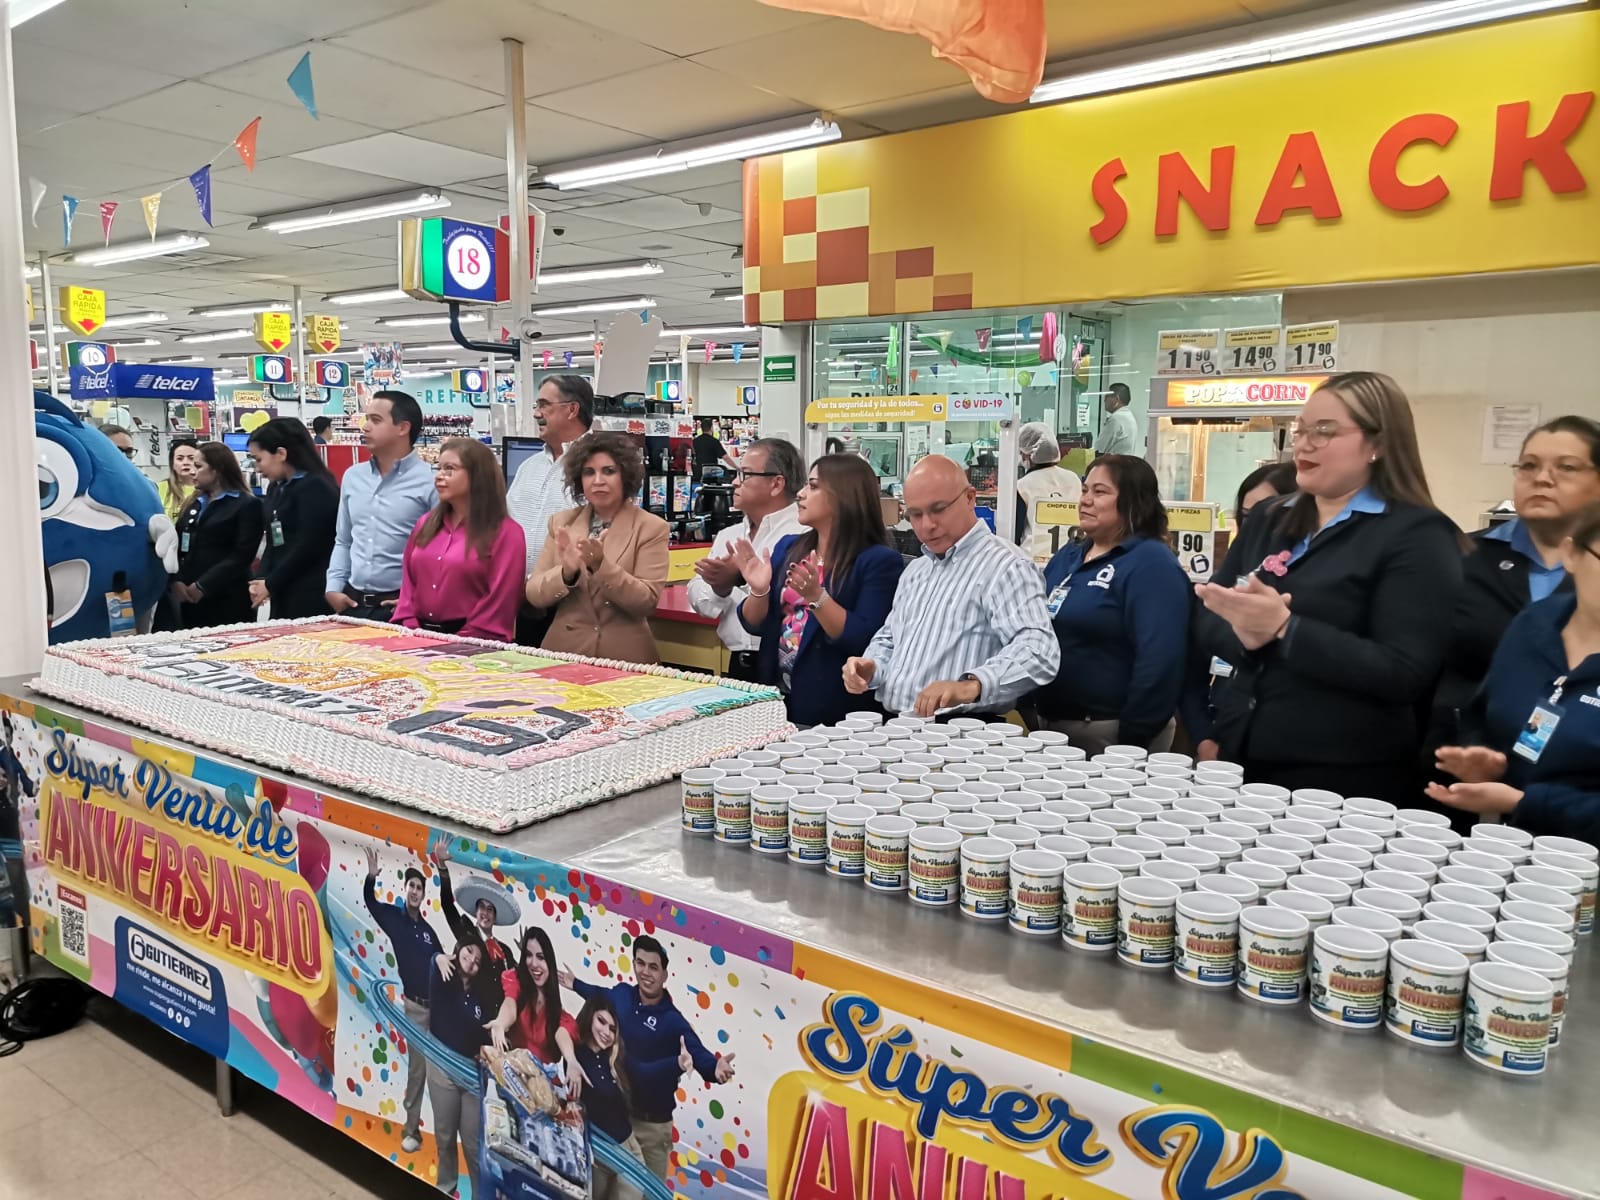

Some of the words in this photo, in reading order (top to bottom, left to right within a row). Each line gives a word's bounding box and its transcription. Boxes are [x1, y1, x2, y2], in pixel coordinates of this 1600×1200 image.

[1089, 90, 1594, 245] SNACK
[457, 247, 481, 275] 18
[77, 293, 98, 302] CAJA
[88, 351, 99, 362] 10
[1233, 346, 1257, 367] 14
[1258, 347, 1273, 359] 90
[1294, 343, 1316, 365] 17
[1318, 342, 1332, 356] 90
[153, 376, 200, 391] telcel
[1247, 384, 1308, 401] CORN
[1182, 533, 1204, 553] 90
[136, 759, 243, 839] Venta
[246, 799, 298, 858] de
[47, 792, 322, 981] ANIVERSARIO
[145, 943, 210, 990] GUTIERREZ
[804, 994, 1112, 1168] Súper
